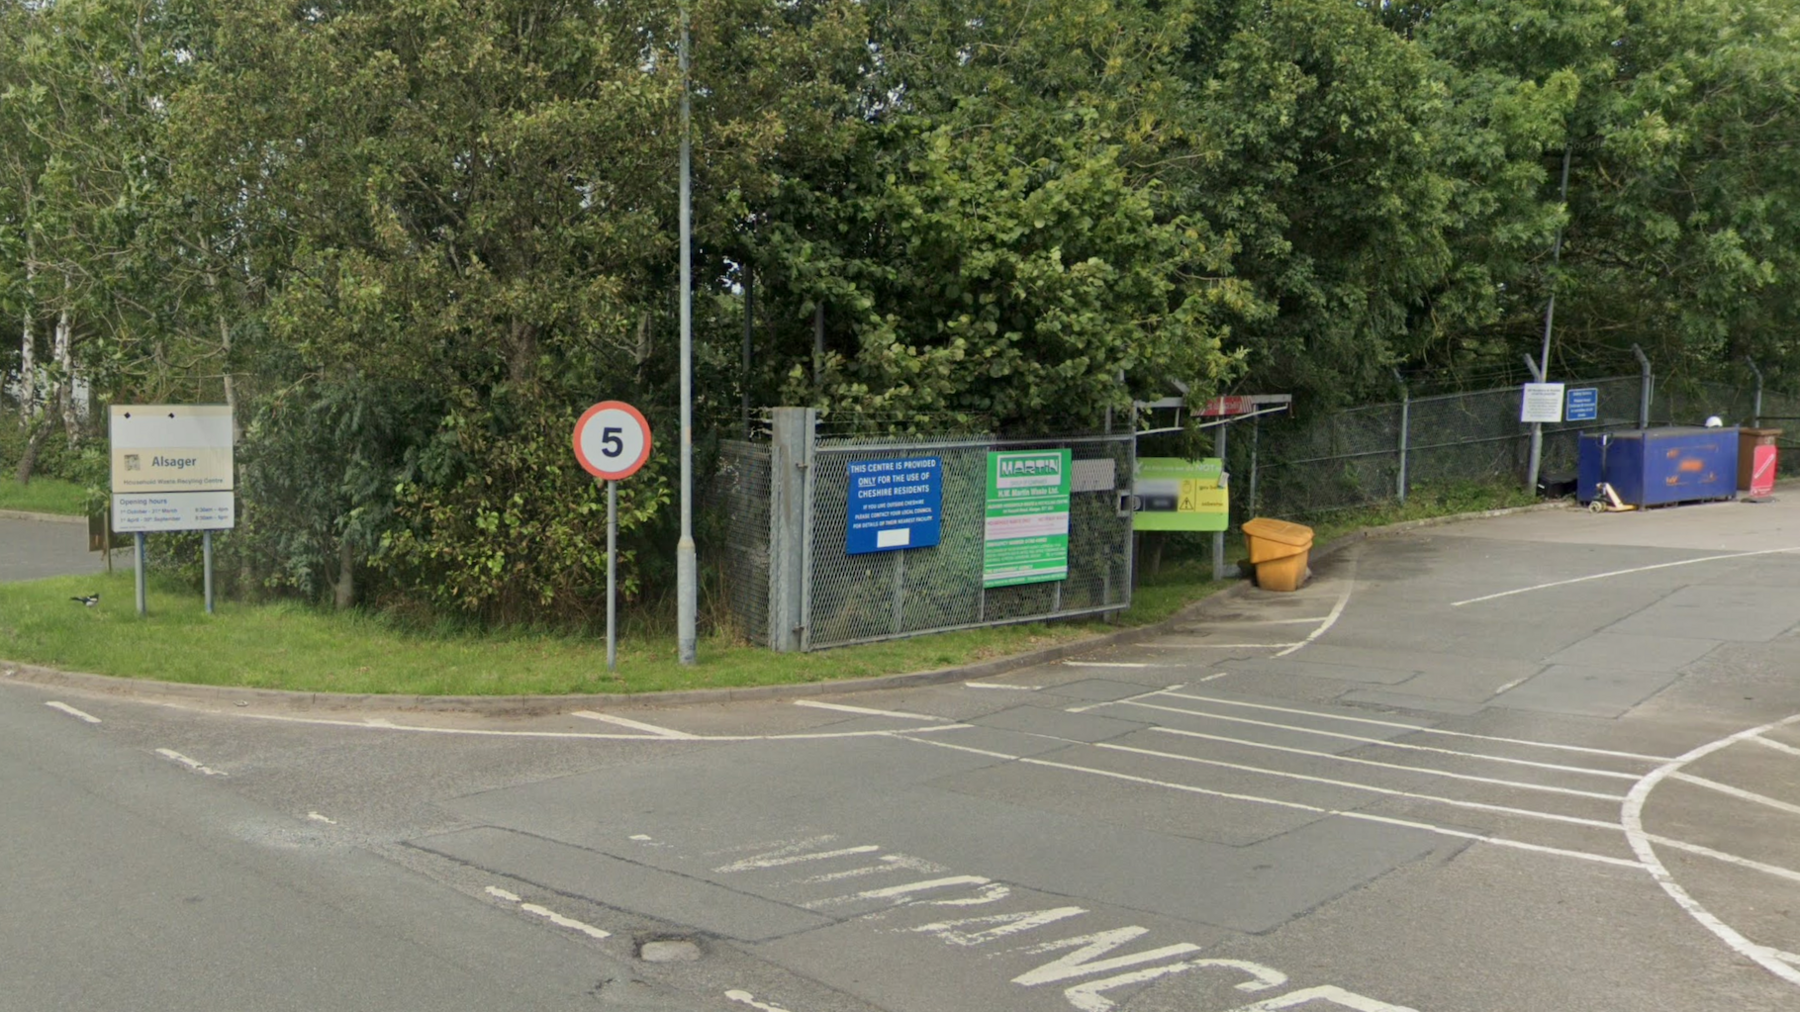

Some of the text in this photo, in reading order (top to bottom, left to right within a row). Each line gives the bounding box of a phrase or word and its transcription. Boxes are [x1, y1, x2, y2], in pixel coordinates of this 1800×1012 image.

[602, 427, 624, 458] 5
[152, 456, 197, 470] Alsager
[851, 459, 936, 474] THIS CENTRE IS PROVIDED
[1002, 459, 1059, 476] MARTIN
[1196, 464, 1217, 472] NOT
[858, 472, 930, 487] ONLY FOR THE USE OF
[858, 484, 930, 498] CHESHIRE RESIDENTS
[1012, 487, 1030, 497] Martin
[120, 498, 147, 506] Opening
